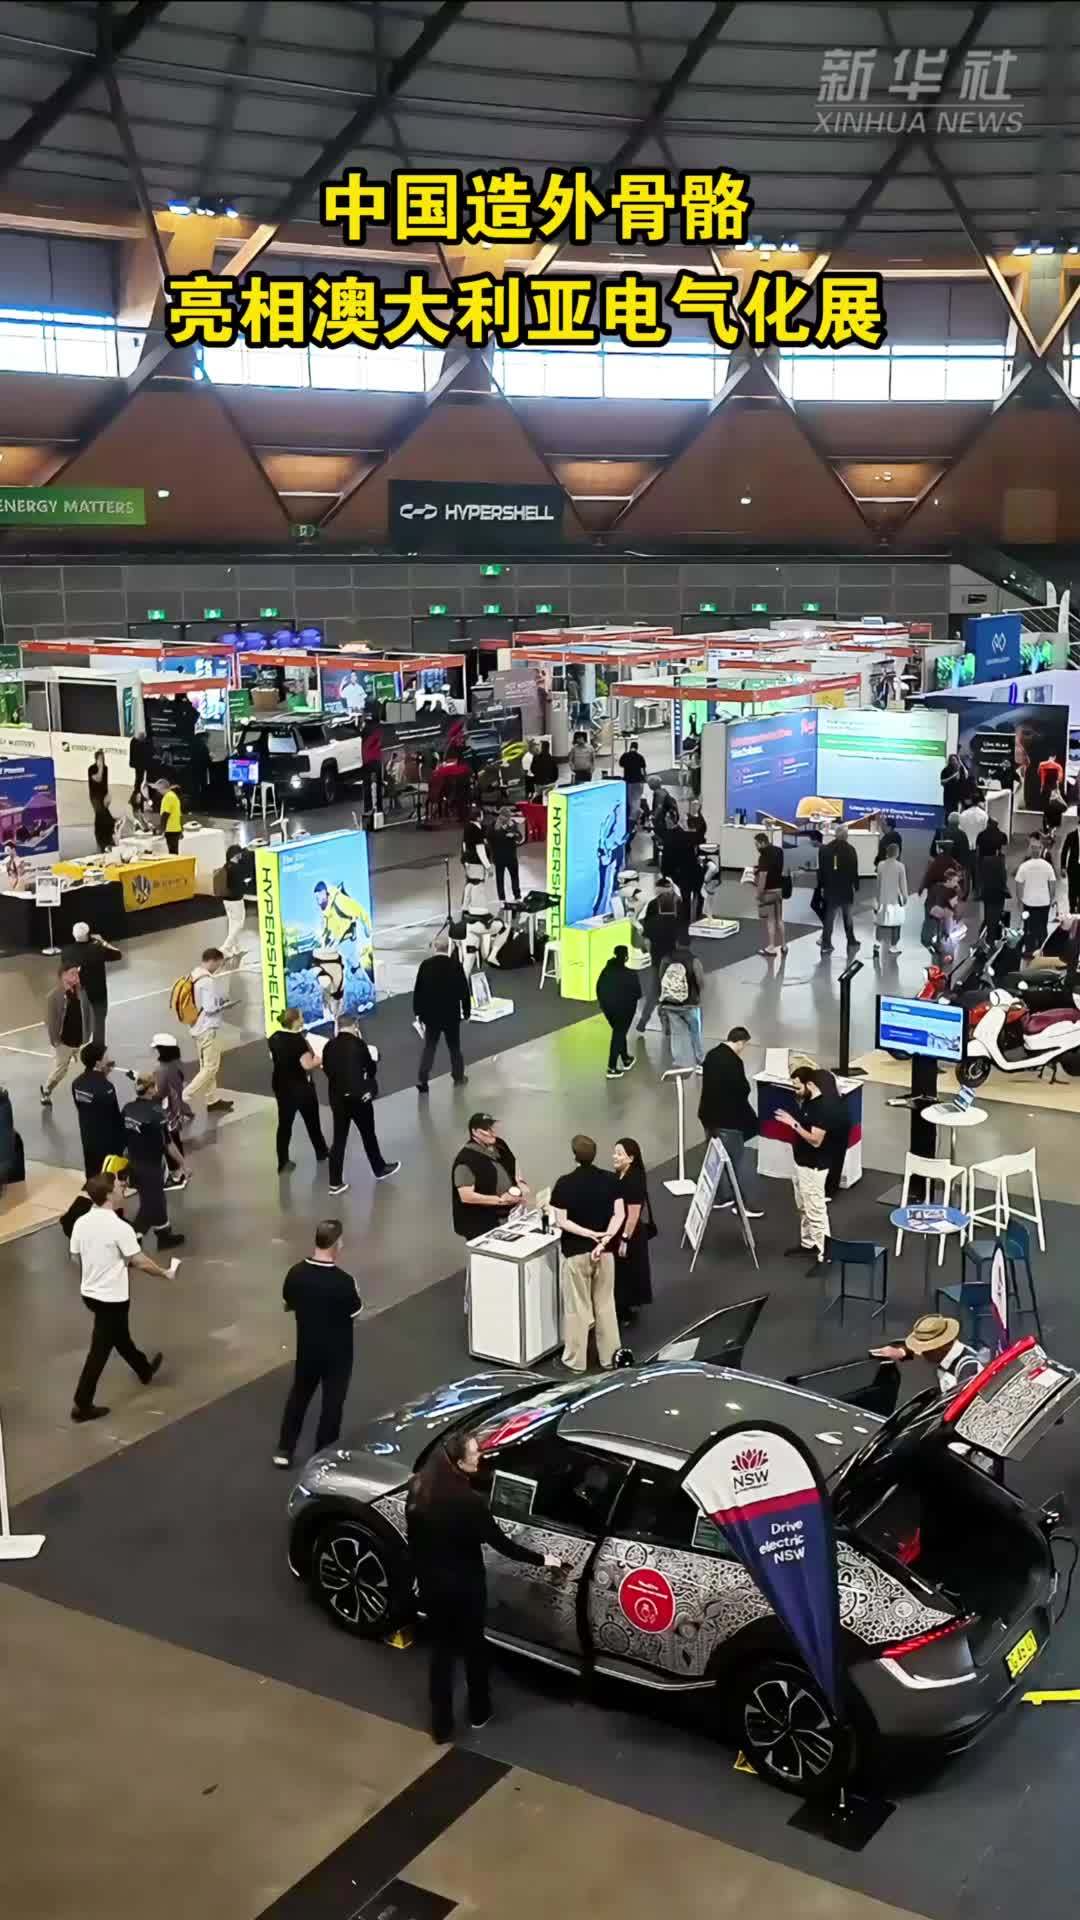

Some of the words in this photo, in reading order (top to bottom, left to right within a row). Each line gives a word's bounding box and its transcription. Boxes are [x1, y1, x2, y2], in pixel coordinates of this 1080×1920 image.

[0, 499, 58, 513] ENERGY
[63, 500, 135, 514] MATTERS
[445, 504, 554, 520] HYPERSHELL
[262, 867, 280, 1022] HYPERSHELL
[732, 1469, 769, 1489] NSW
[771, 1520, 803, 1535] Drive
[759, 1534, 804, 1555] electric
[773, 1546, 805, 1564] NSW
